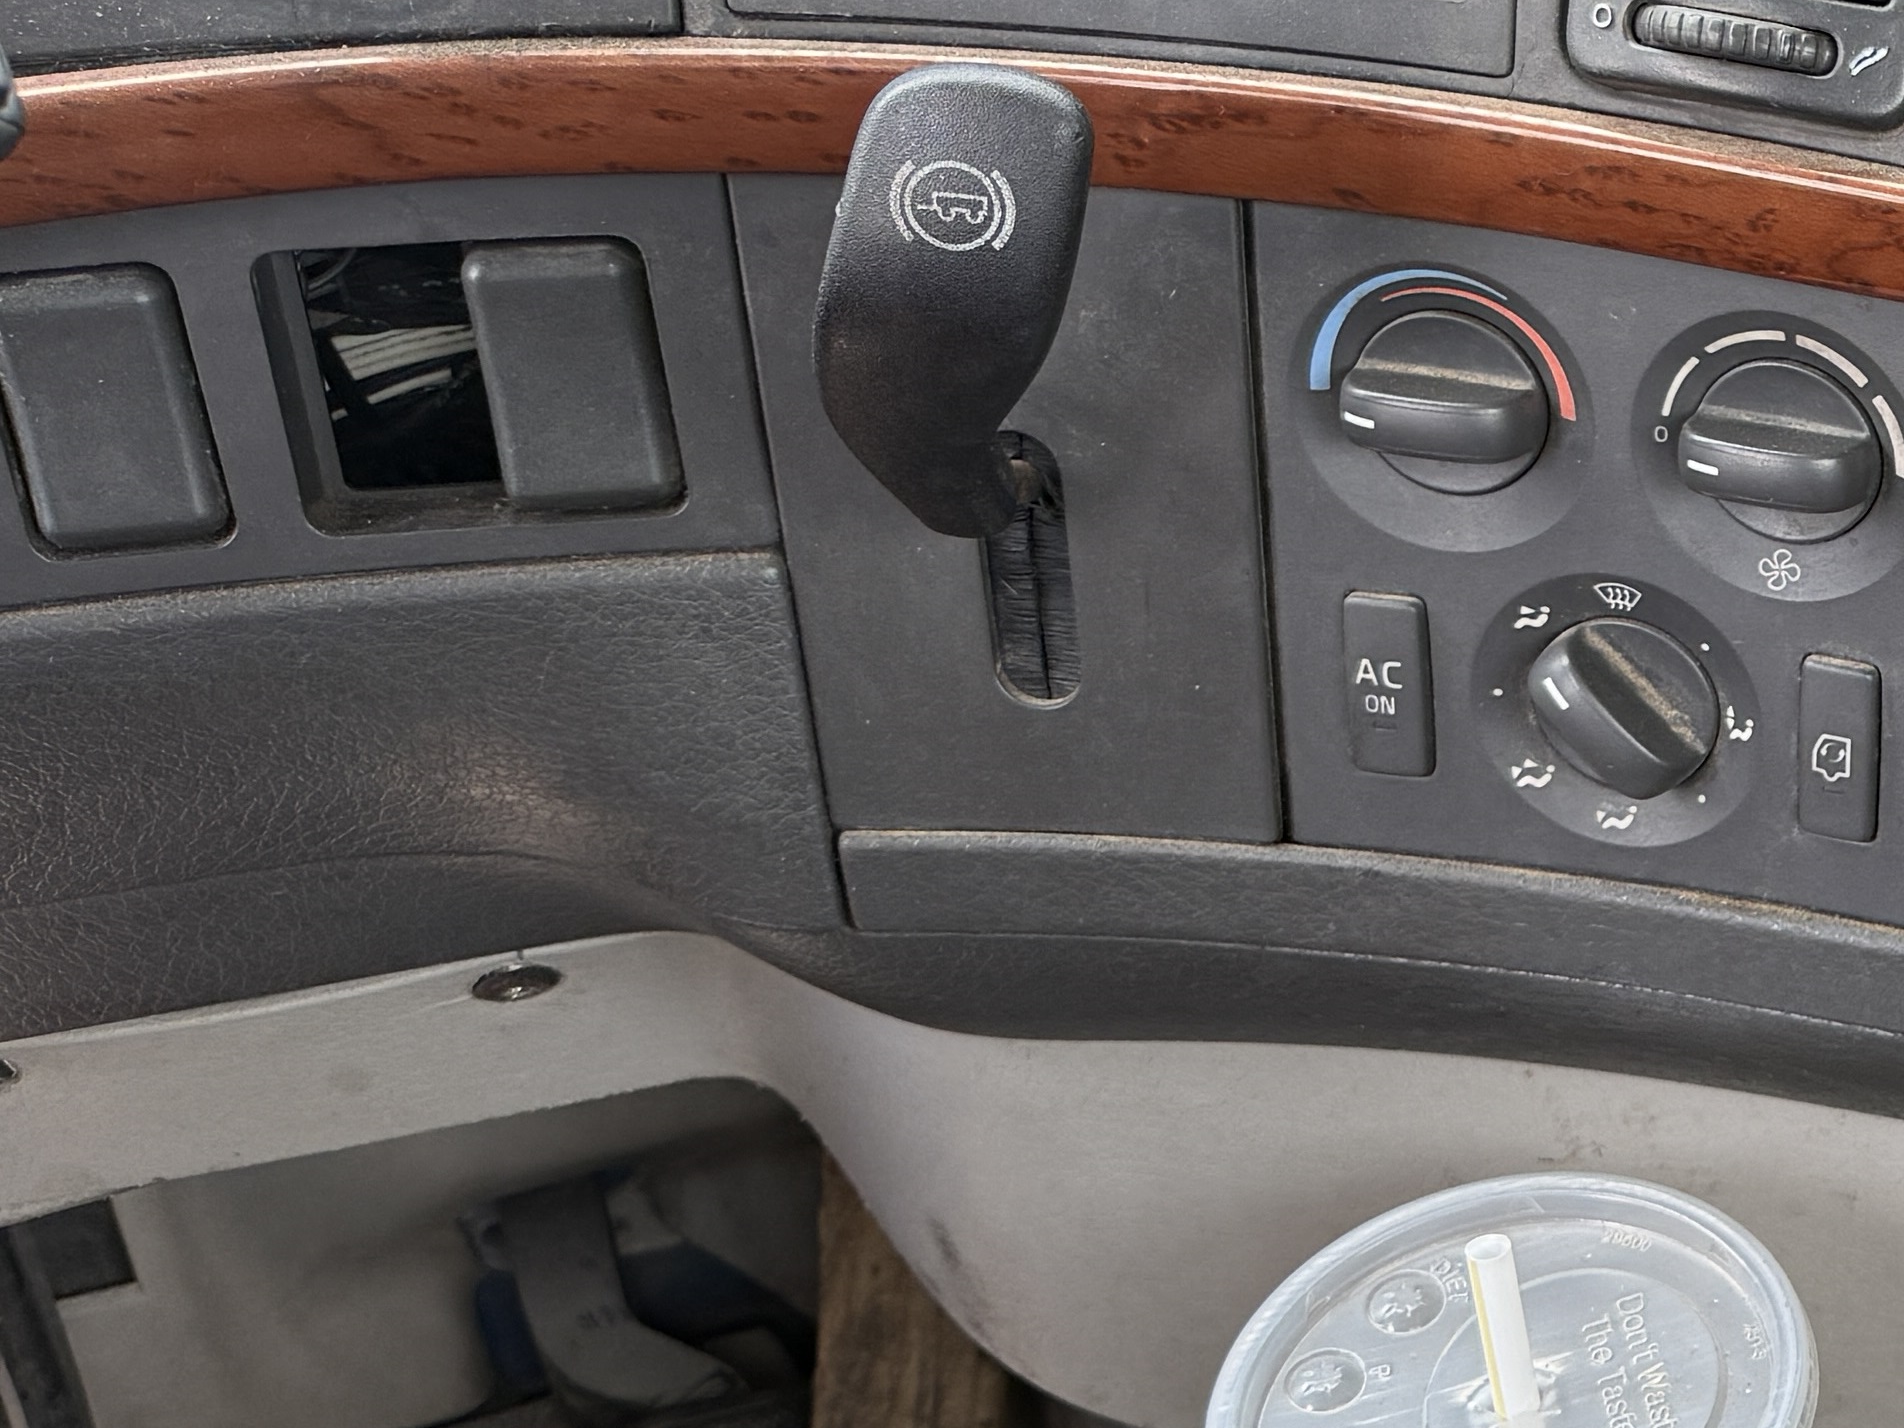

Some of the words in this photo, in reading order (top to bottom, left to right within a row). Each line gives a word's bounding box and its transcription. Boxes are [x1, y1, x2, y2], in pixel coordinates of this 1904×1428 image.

[1355, 658, 1403, 689] AC
[1365, 694, 1396, 715] ON
[1581, 1313, 1614, 1366] The
[1615, 1292, 1659, 1365] Don't
